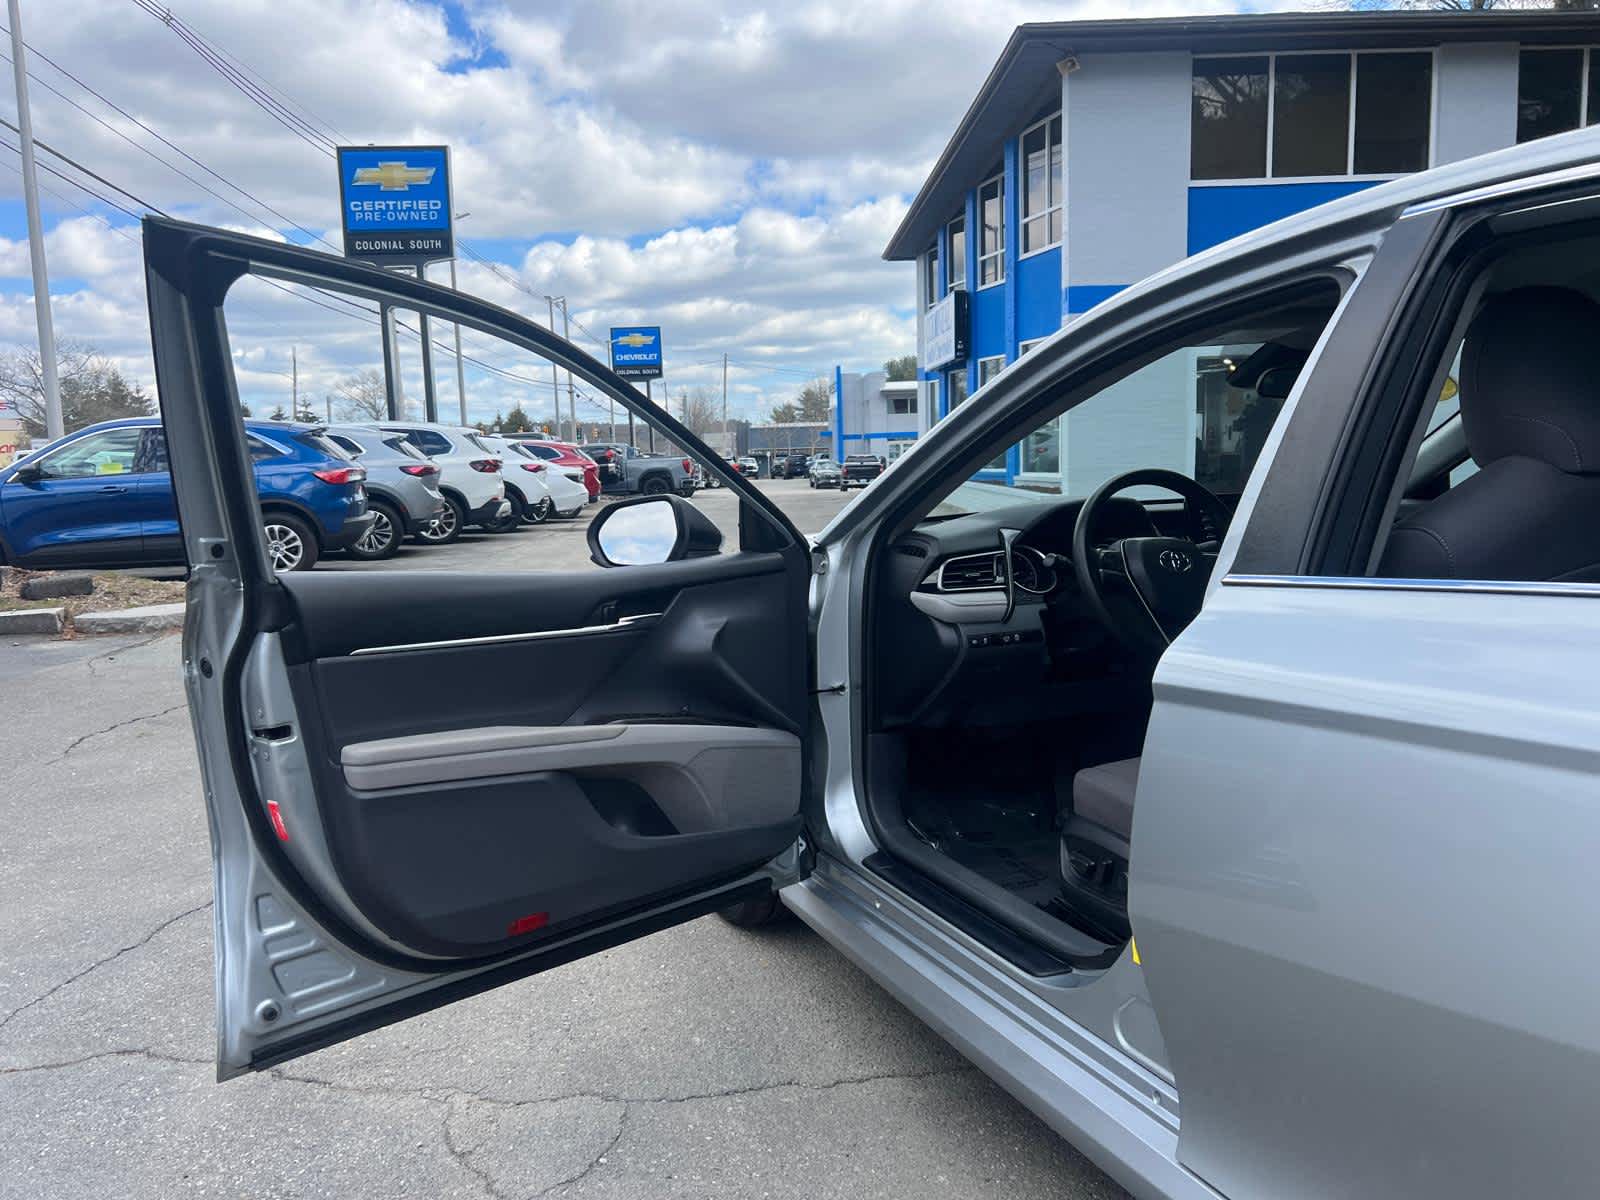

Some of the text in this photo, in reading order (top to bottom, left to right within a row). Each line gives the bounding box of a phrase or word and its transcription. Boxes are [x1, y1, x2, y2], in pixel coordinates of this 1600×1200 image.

[350, 200, 441, 211] CERTIFIED
[355, 211, 438, 221] PRE-OWNED
[355, 240, 441, 249] COLONIAL SOUTH
